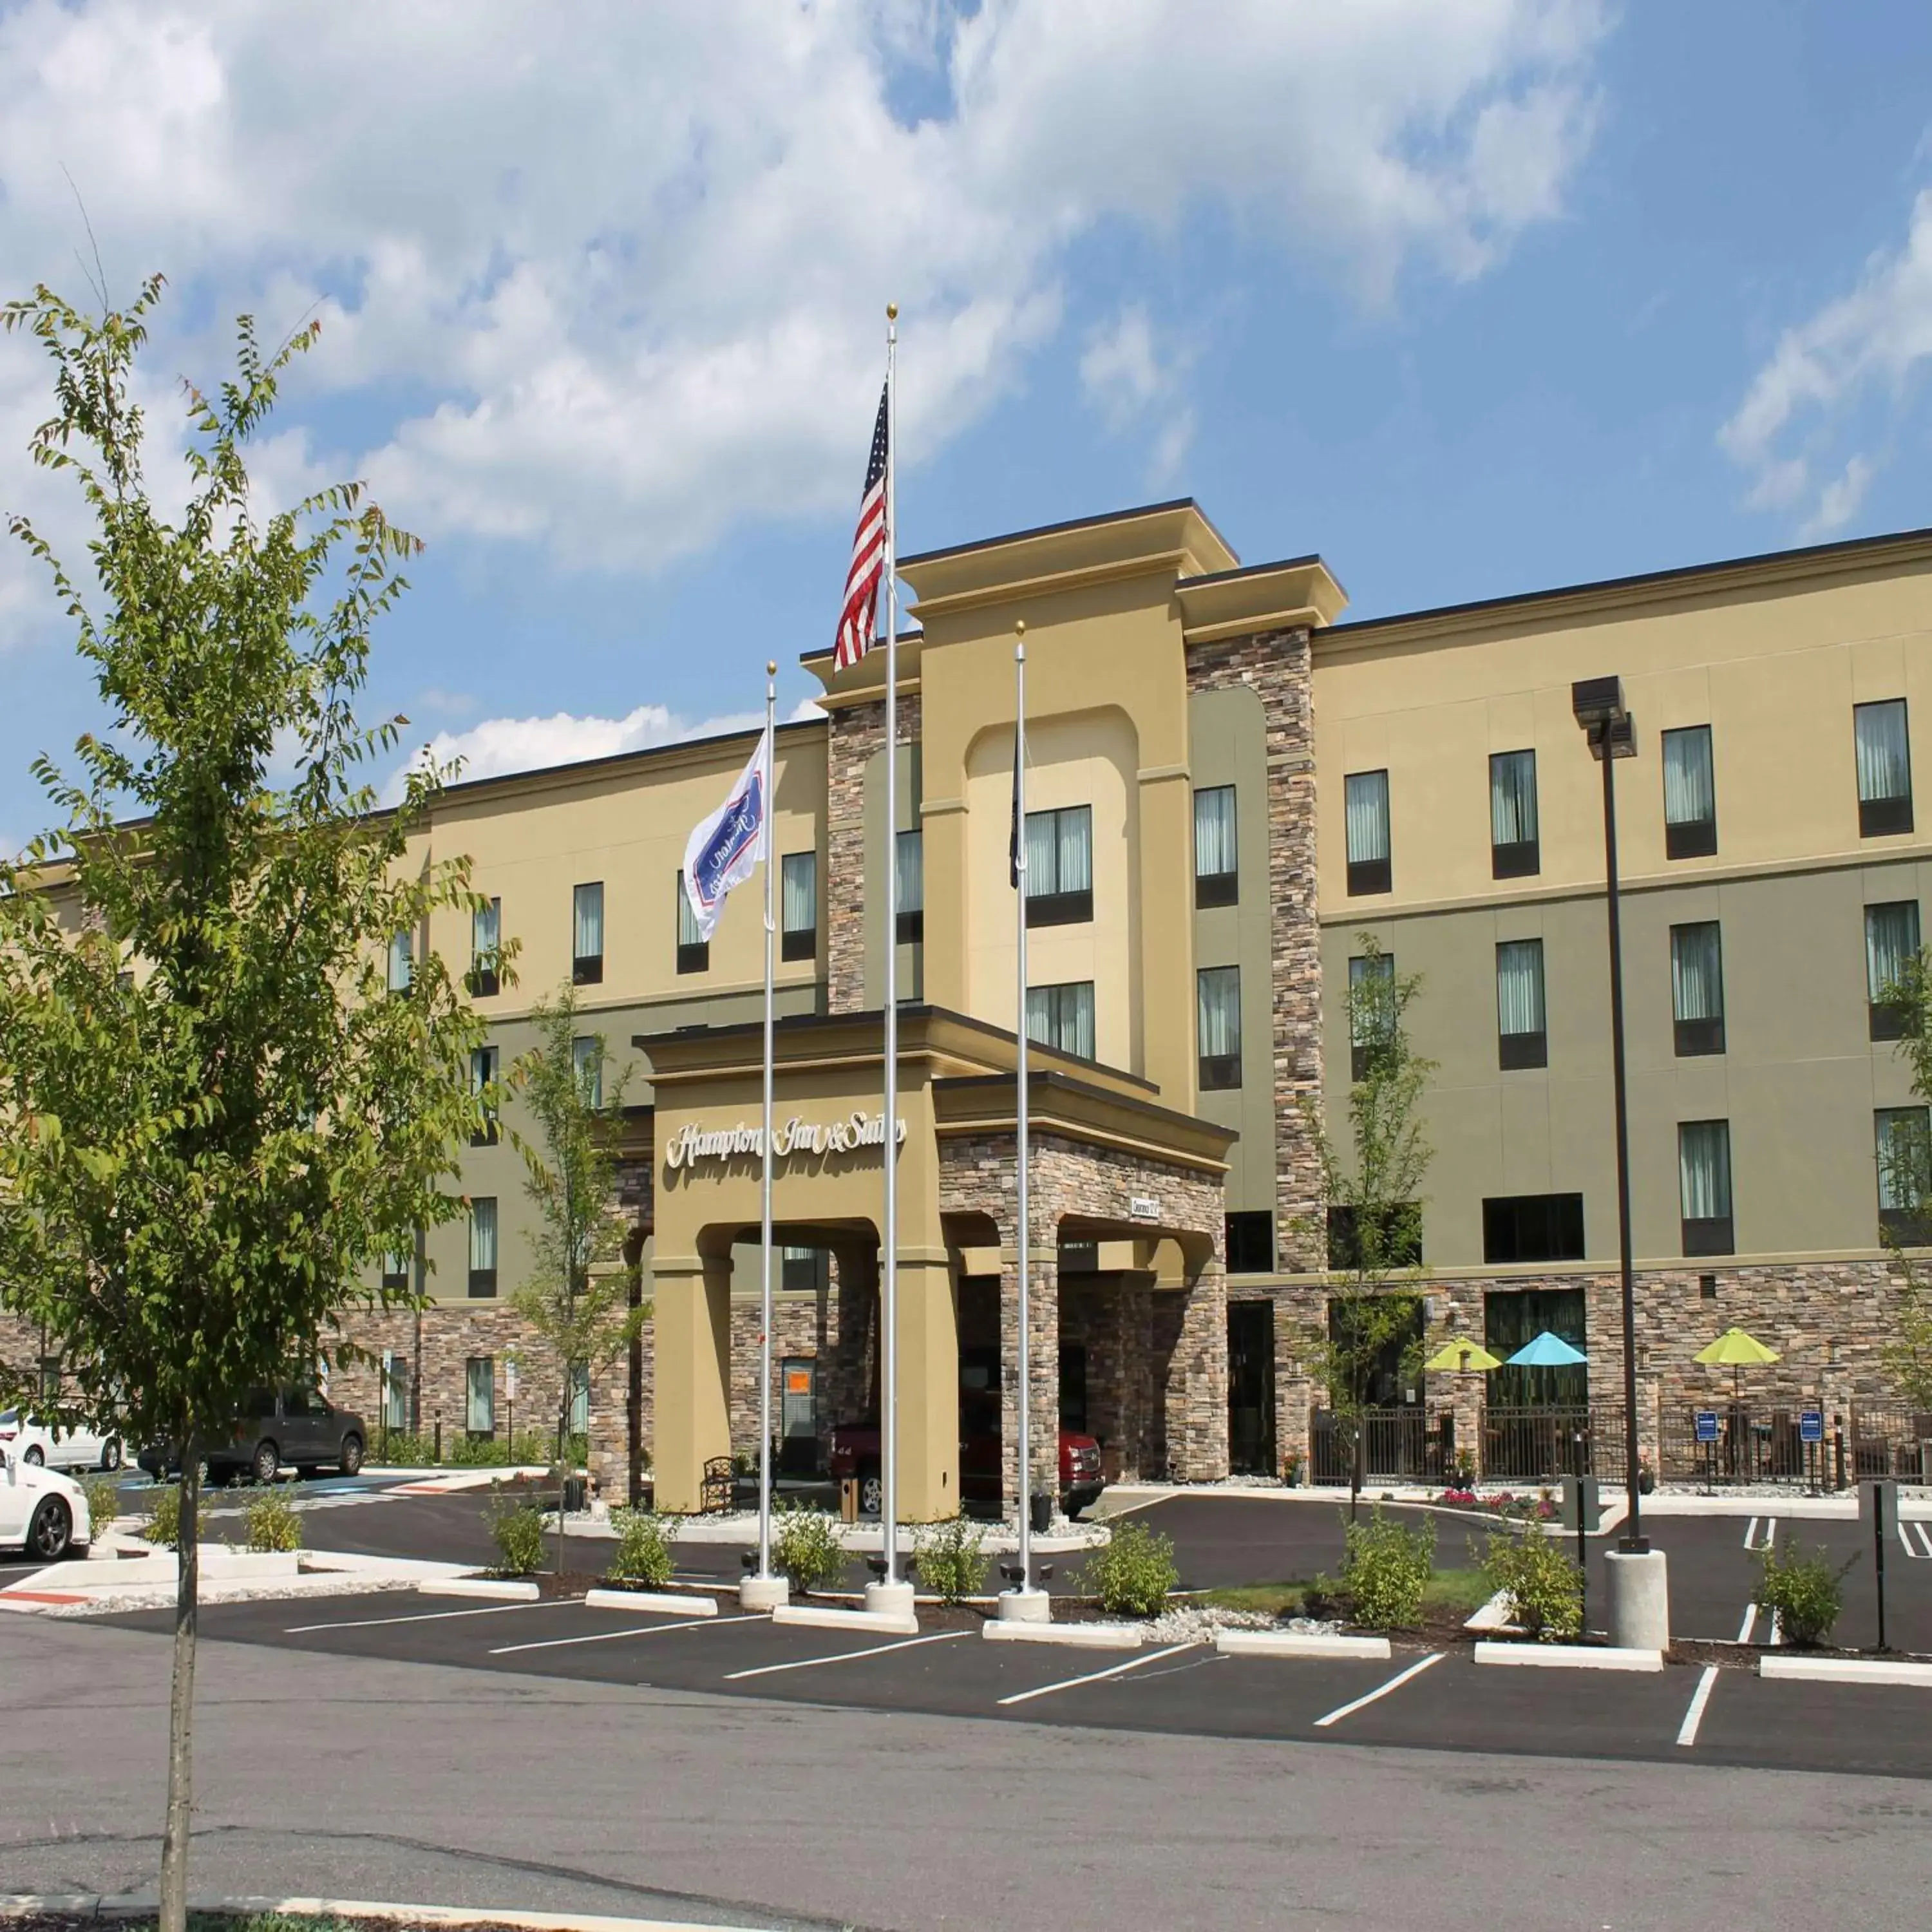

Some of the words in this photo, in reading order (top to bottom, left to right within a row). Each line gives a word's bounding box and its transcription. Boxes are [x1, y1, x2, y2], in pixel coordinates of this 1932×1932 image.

[666, 1121, 764, 1168] Hampton
[771, 1115, 830, 1155] Inn
[844, 1112, 907, 1149] Suits
